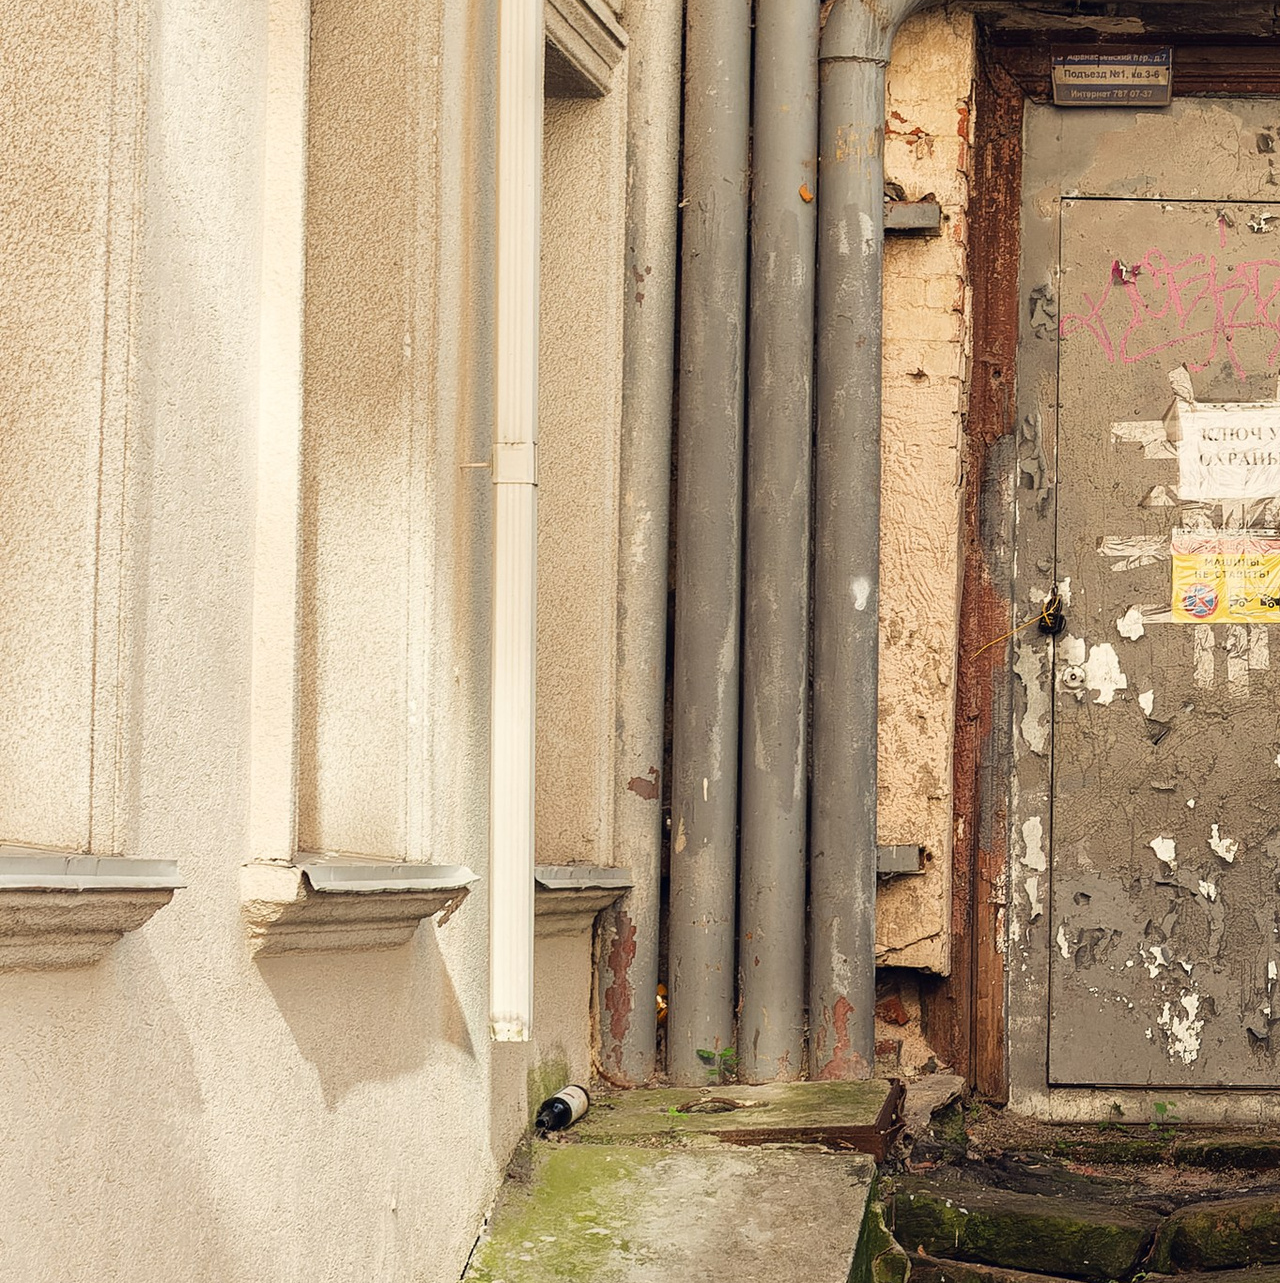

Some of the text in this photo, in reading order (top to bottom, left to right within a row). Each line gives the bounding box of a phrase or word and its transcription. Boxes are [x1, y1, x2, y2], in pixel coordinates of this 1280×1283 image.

[1064, 69, 1107, 79] Подъезд
[1109, 69, 1129, 79] №1,
[1070, 89, 1153, 98] Интернет 787 07-37
[1202, 427, 1279, 441] КЛЮЧ У
[1204, 558, 1260, 567] МАШИНЫ
[1194, 570, 1210, 579] НЕ
